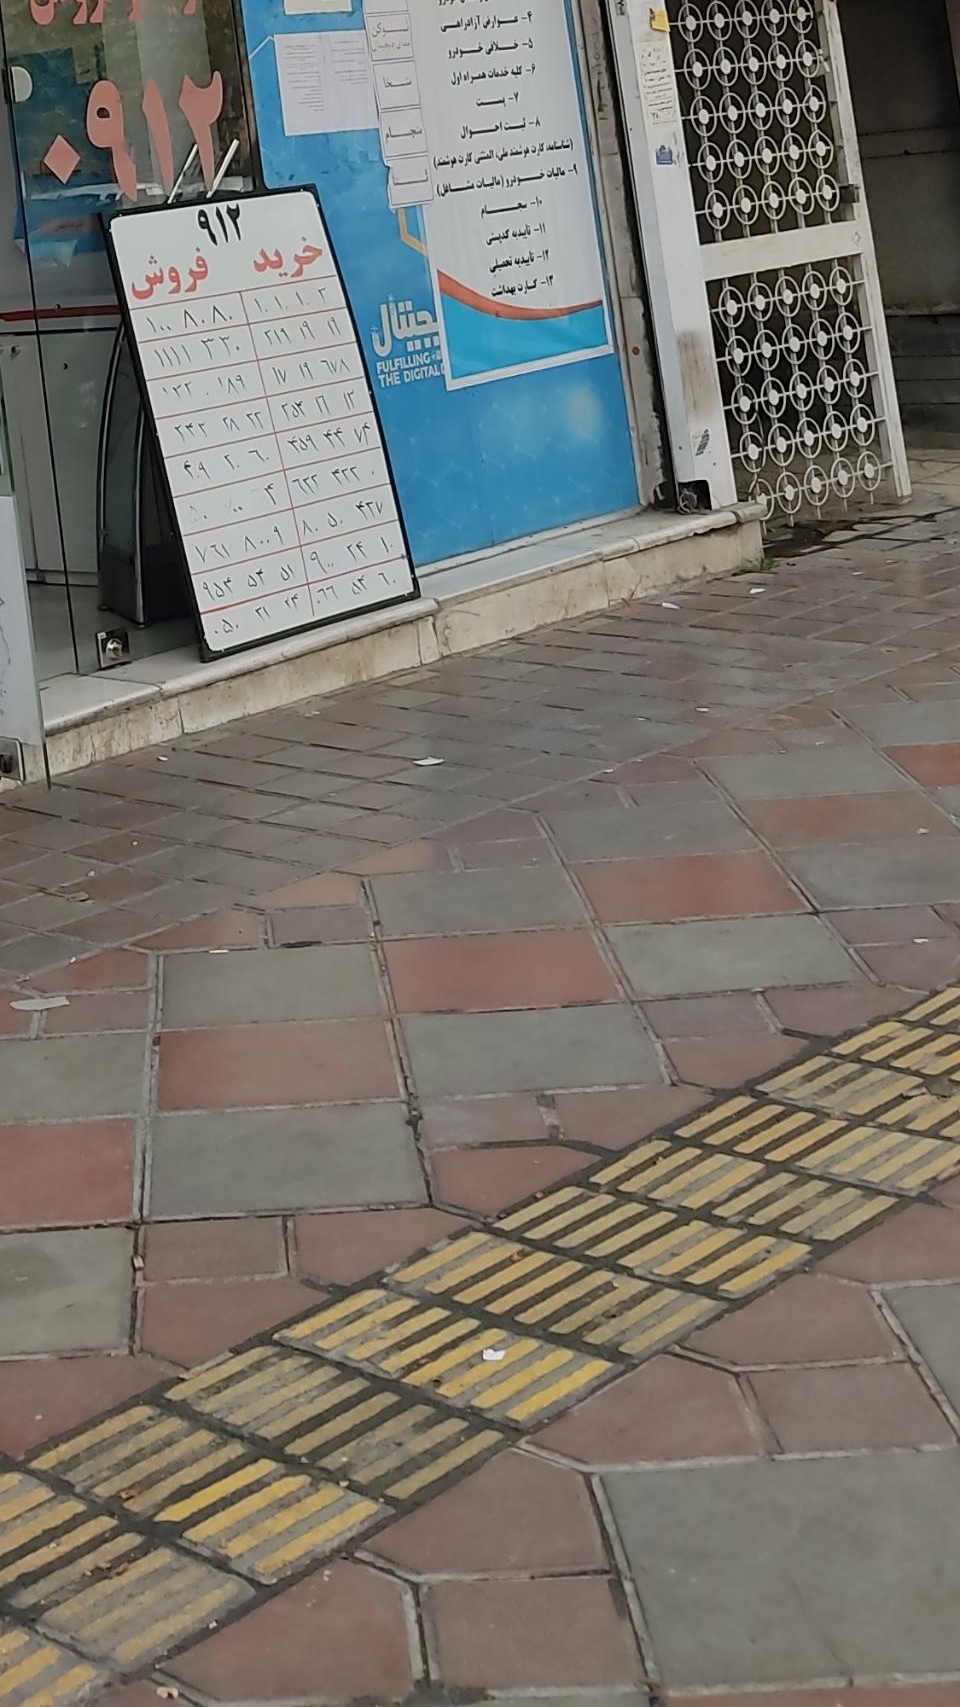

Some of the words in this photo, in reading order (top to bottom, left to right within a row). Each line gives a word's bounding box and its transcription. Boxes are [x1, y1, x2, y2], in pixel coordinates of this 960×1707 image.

[448, 42, 484, 59] خودرو
[451, 71, 462, 85] اول
[464, 70, 486, 83] همراه
[488, 66, 509, 79] خدمات
[43, 70, 224, 203] ۰۹۱۲
[460, 121, 502, 139] احوال
[197, 203, 241, 246] ۹۱۲
[253, 236, 323, 278] خرید
[131, 246, 209, 300] فروش
[376, 352, 431, 375] FULFILLING
[378, 371, 402, 388] THE
[403, 363, 441, 383] DIGITAL
